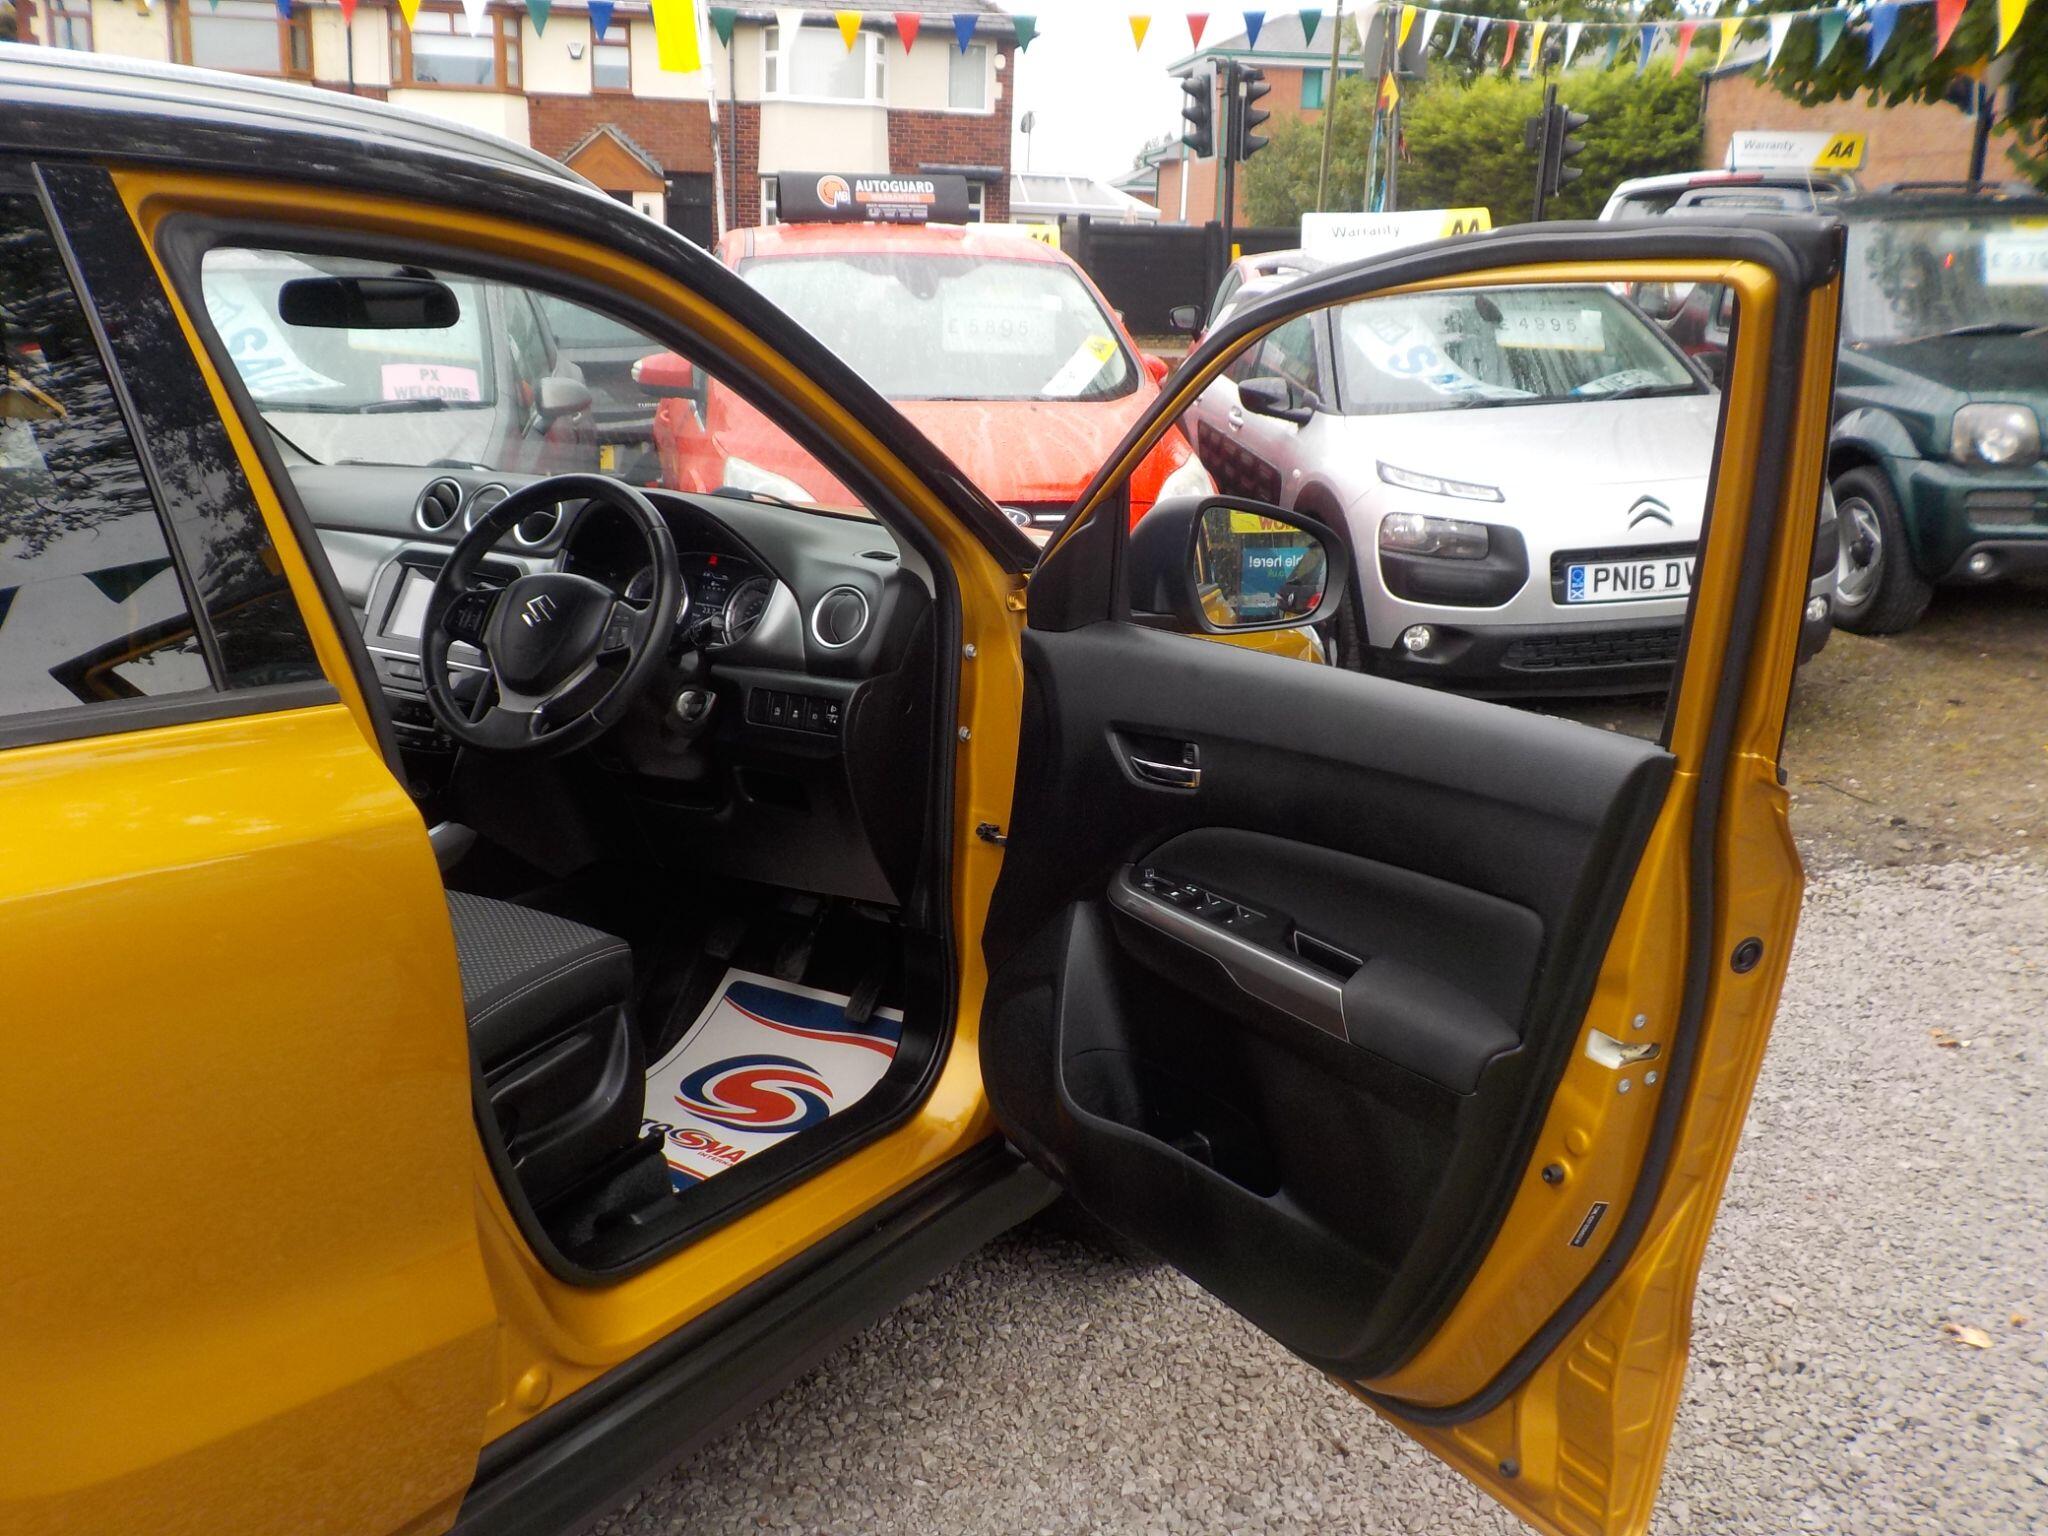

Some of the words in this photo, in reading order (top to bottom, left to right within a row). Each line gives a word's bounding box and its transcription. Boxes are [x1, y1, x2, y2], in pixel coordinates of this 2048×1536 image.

[1743, 140, 1794, 151] Warranty
[1828, 141, 1856, 158] AA
[855, 180, 934, 193] AUTOGUARD
[1331, 223, 1400, 238] Warranty
[419, 368, 440, 381] PX
[393, 386, 470, 401] WELCOME
[1594, 564, 1656, 593] PN16
